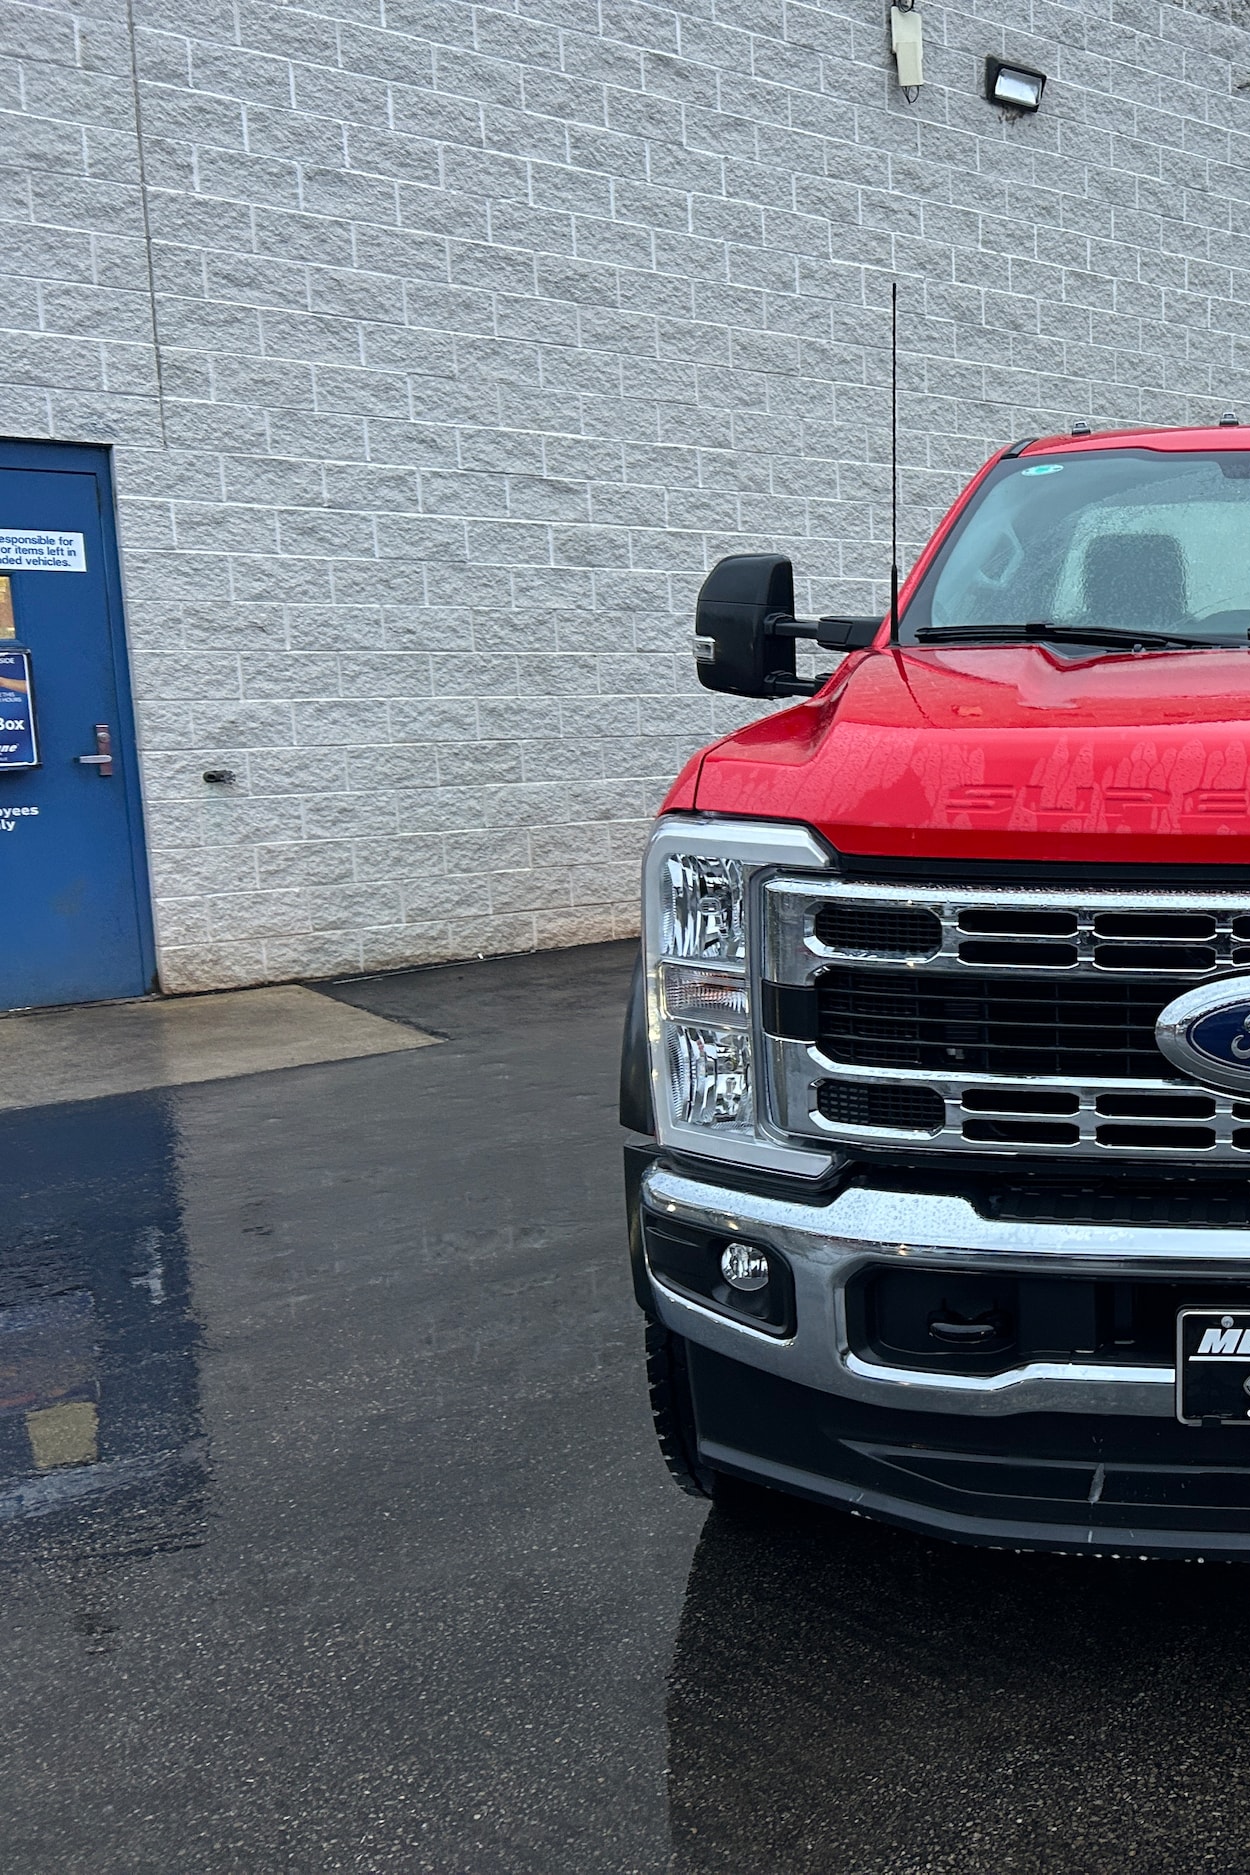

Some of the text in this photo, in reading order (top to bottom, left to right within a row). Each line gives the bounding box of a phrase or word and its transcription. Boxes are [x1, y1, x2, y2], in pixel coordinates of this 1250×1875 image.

[59, 536, 74, 546] for
[0, 545, 77, 556] or items left in
[25, 557, 72, 567] vehicles.
